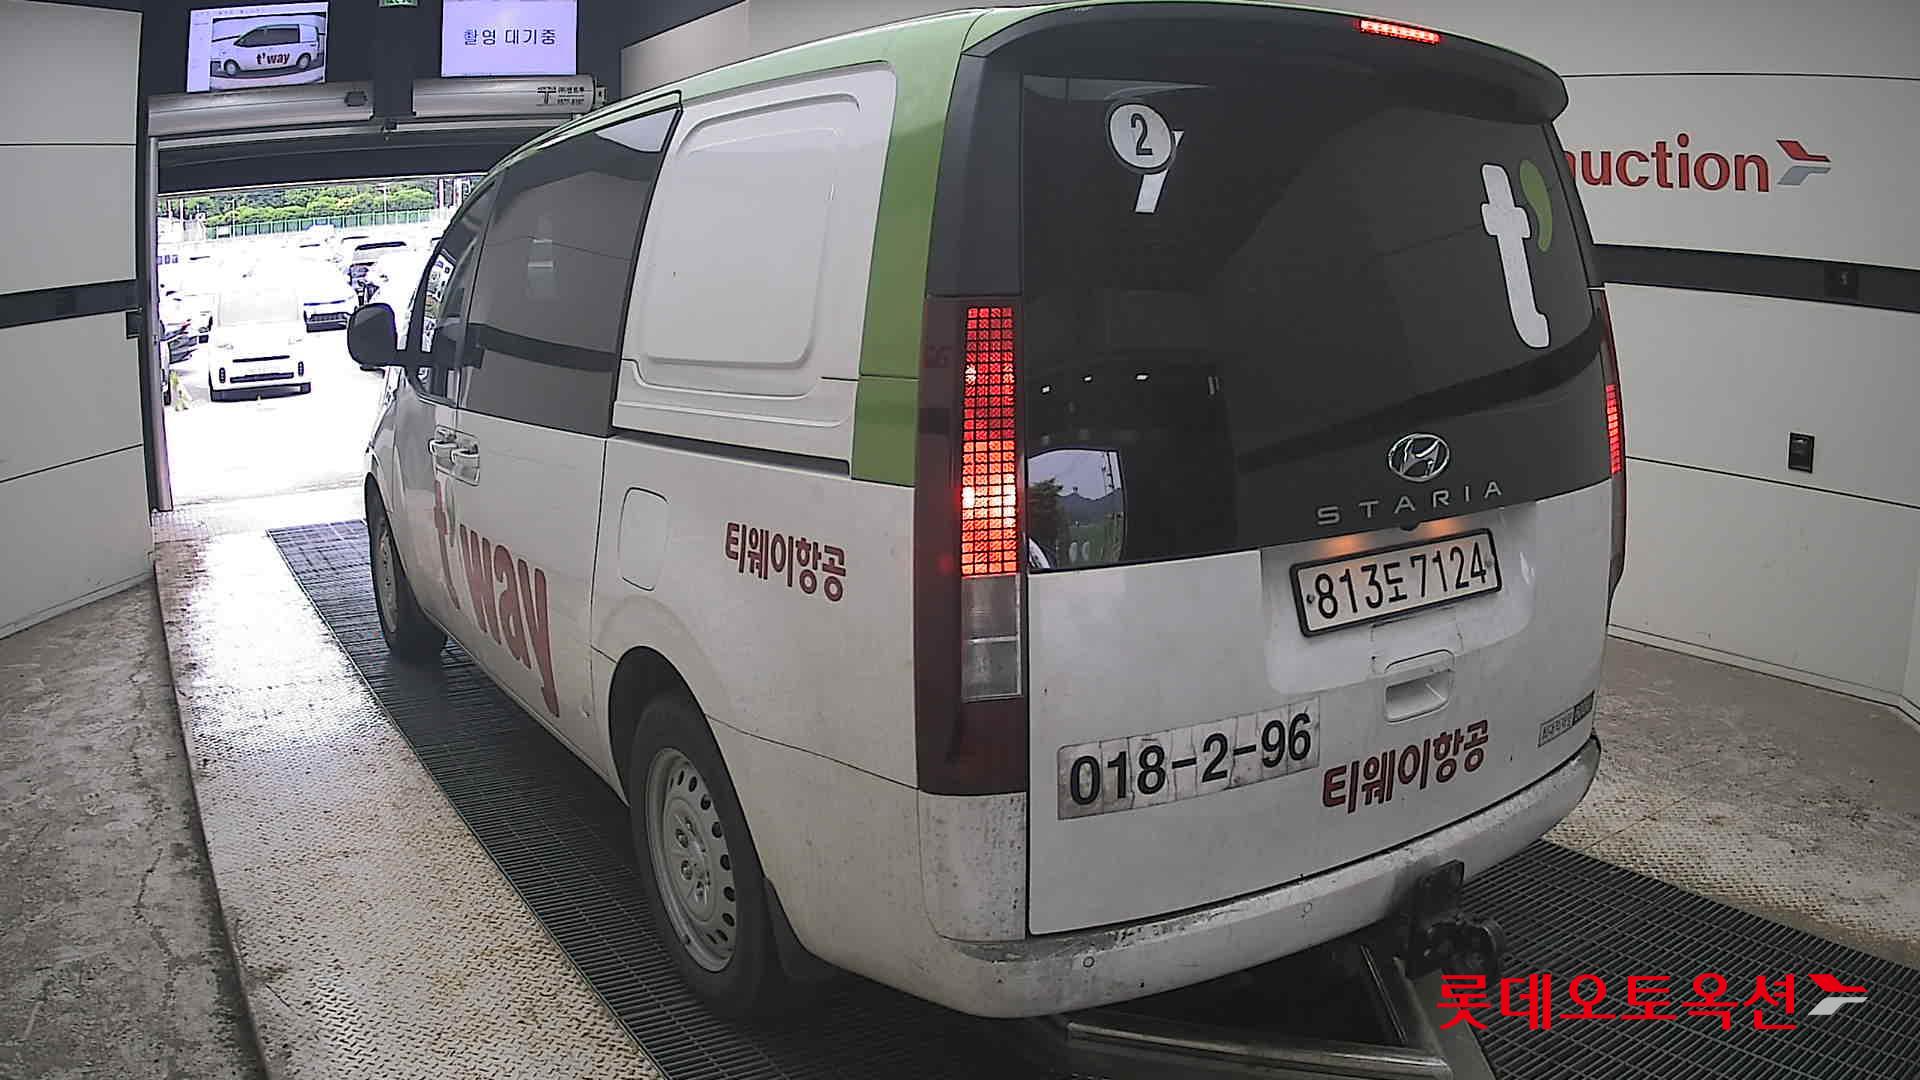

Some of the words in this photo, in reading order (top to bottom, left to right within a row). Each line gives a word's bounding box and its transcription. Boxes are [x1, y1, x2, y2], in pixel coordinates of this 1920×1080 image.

[504, 29, 556, 45] 대기중
[1130, 112, 1153, 156] 2
[1317, 481, 1502, 525] STARIA
[724, 521, 847, 602] 티웨이항공
[1069, 712, 1312, 807] 018-2-96
[1321, 718, 1489, 814] 티웨이항공
